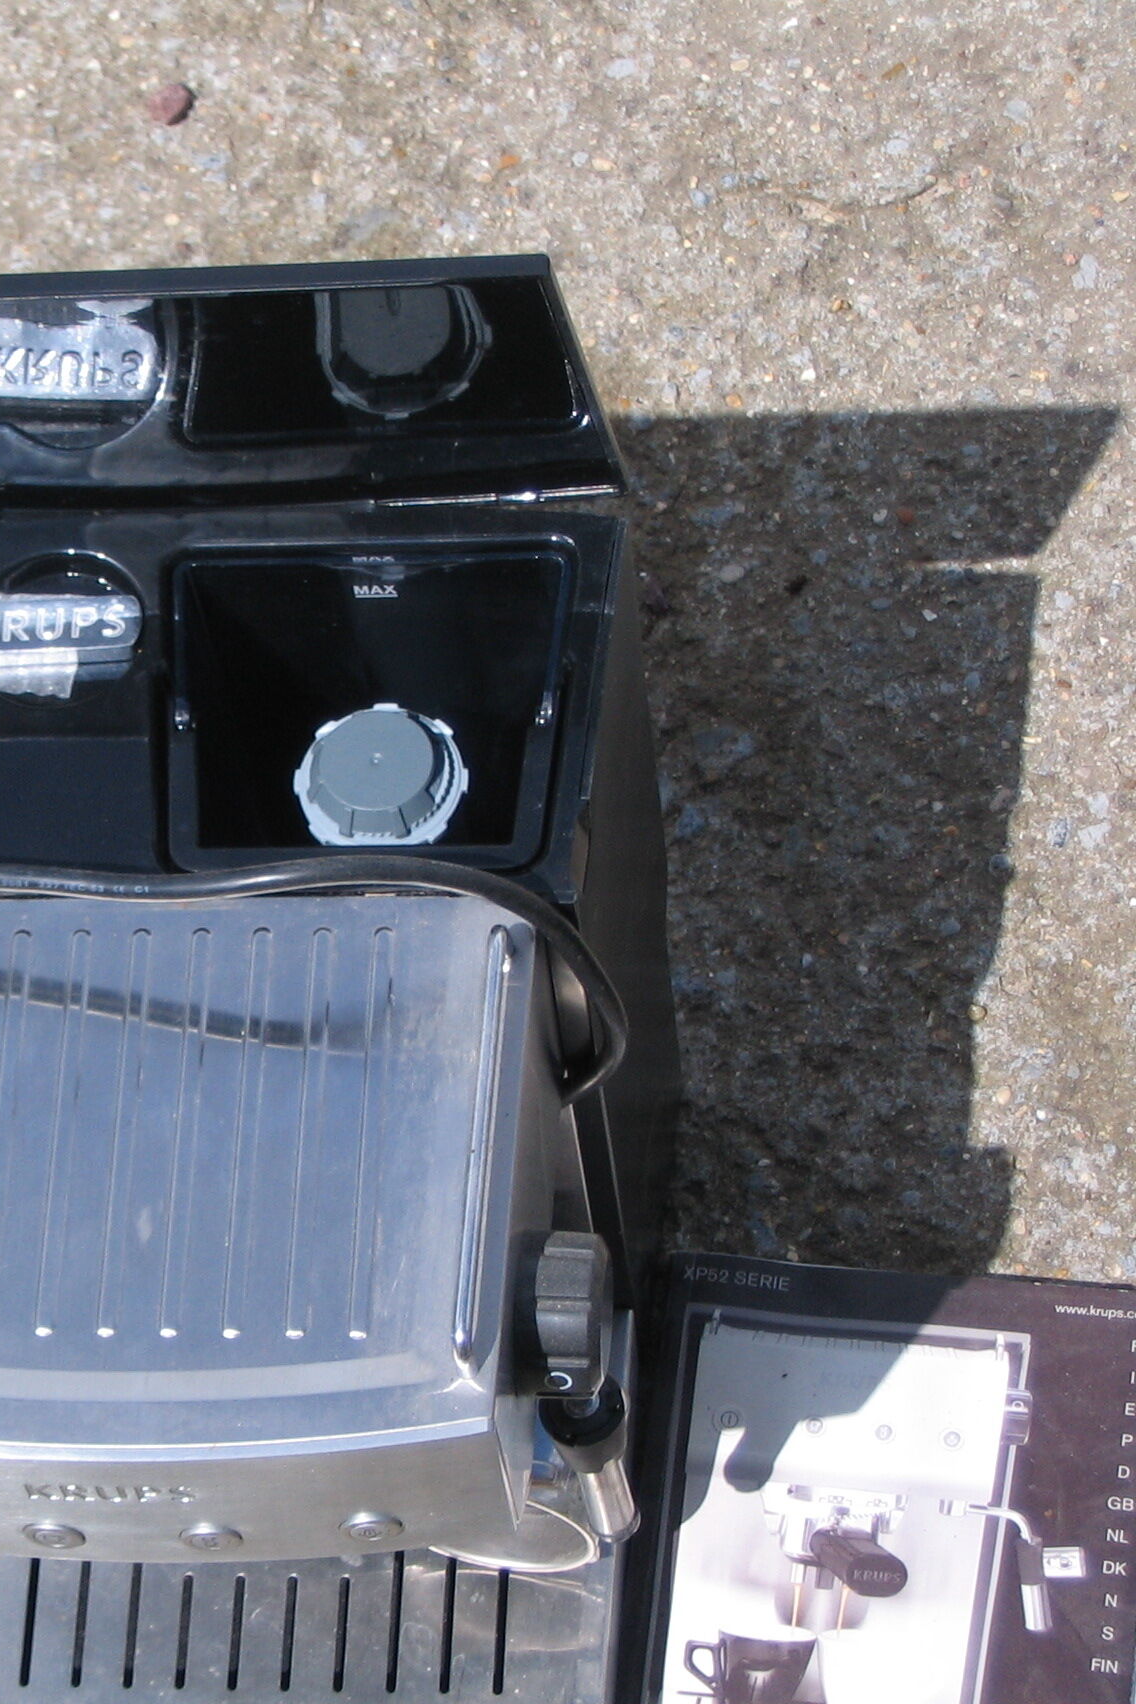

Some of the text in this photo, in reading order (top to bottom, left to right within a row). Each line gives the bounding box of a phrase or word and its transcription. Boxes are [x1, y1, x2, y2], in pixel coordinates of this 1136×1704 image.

[353, 585, 398, 596] MAX
[684, 1265, 790, 1291] XP52 SERIE
[1055, 1304, 1136, 1320] www.krups.c
[1124, 1402, 1136, 1416] E
[1121, 1433, 1133, 1447] P
[1117, 1465, 1130, 1478] D
[24, 1484, 196, 1503] KRUPS
[1107, 1496, 1134, 1511] GB
[1106, 1528, 1129, 1544] NL
[853, 1568, 901, 1583] KRUPS
[1102, 1560, 1127, 1576] DK
[1104, 1593, 1118, 1607] N
[1101, 1626, 1114, 1641] S
[1090, 1658, 1119, 1674] FIN
